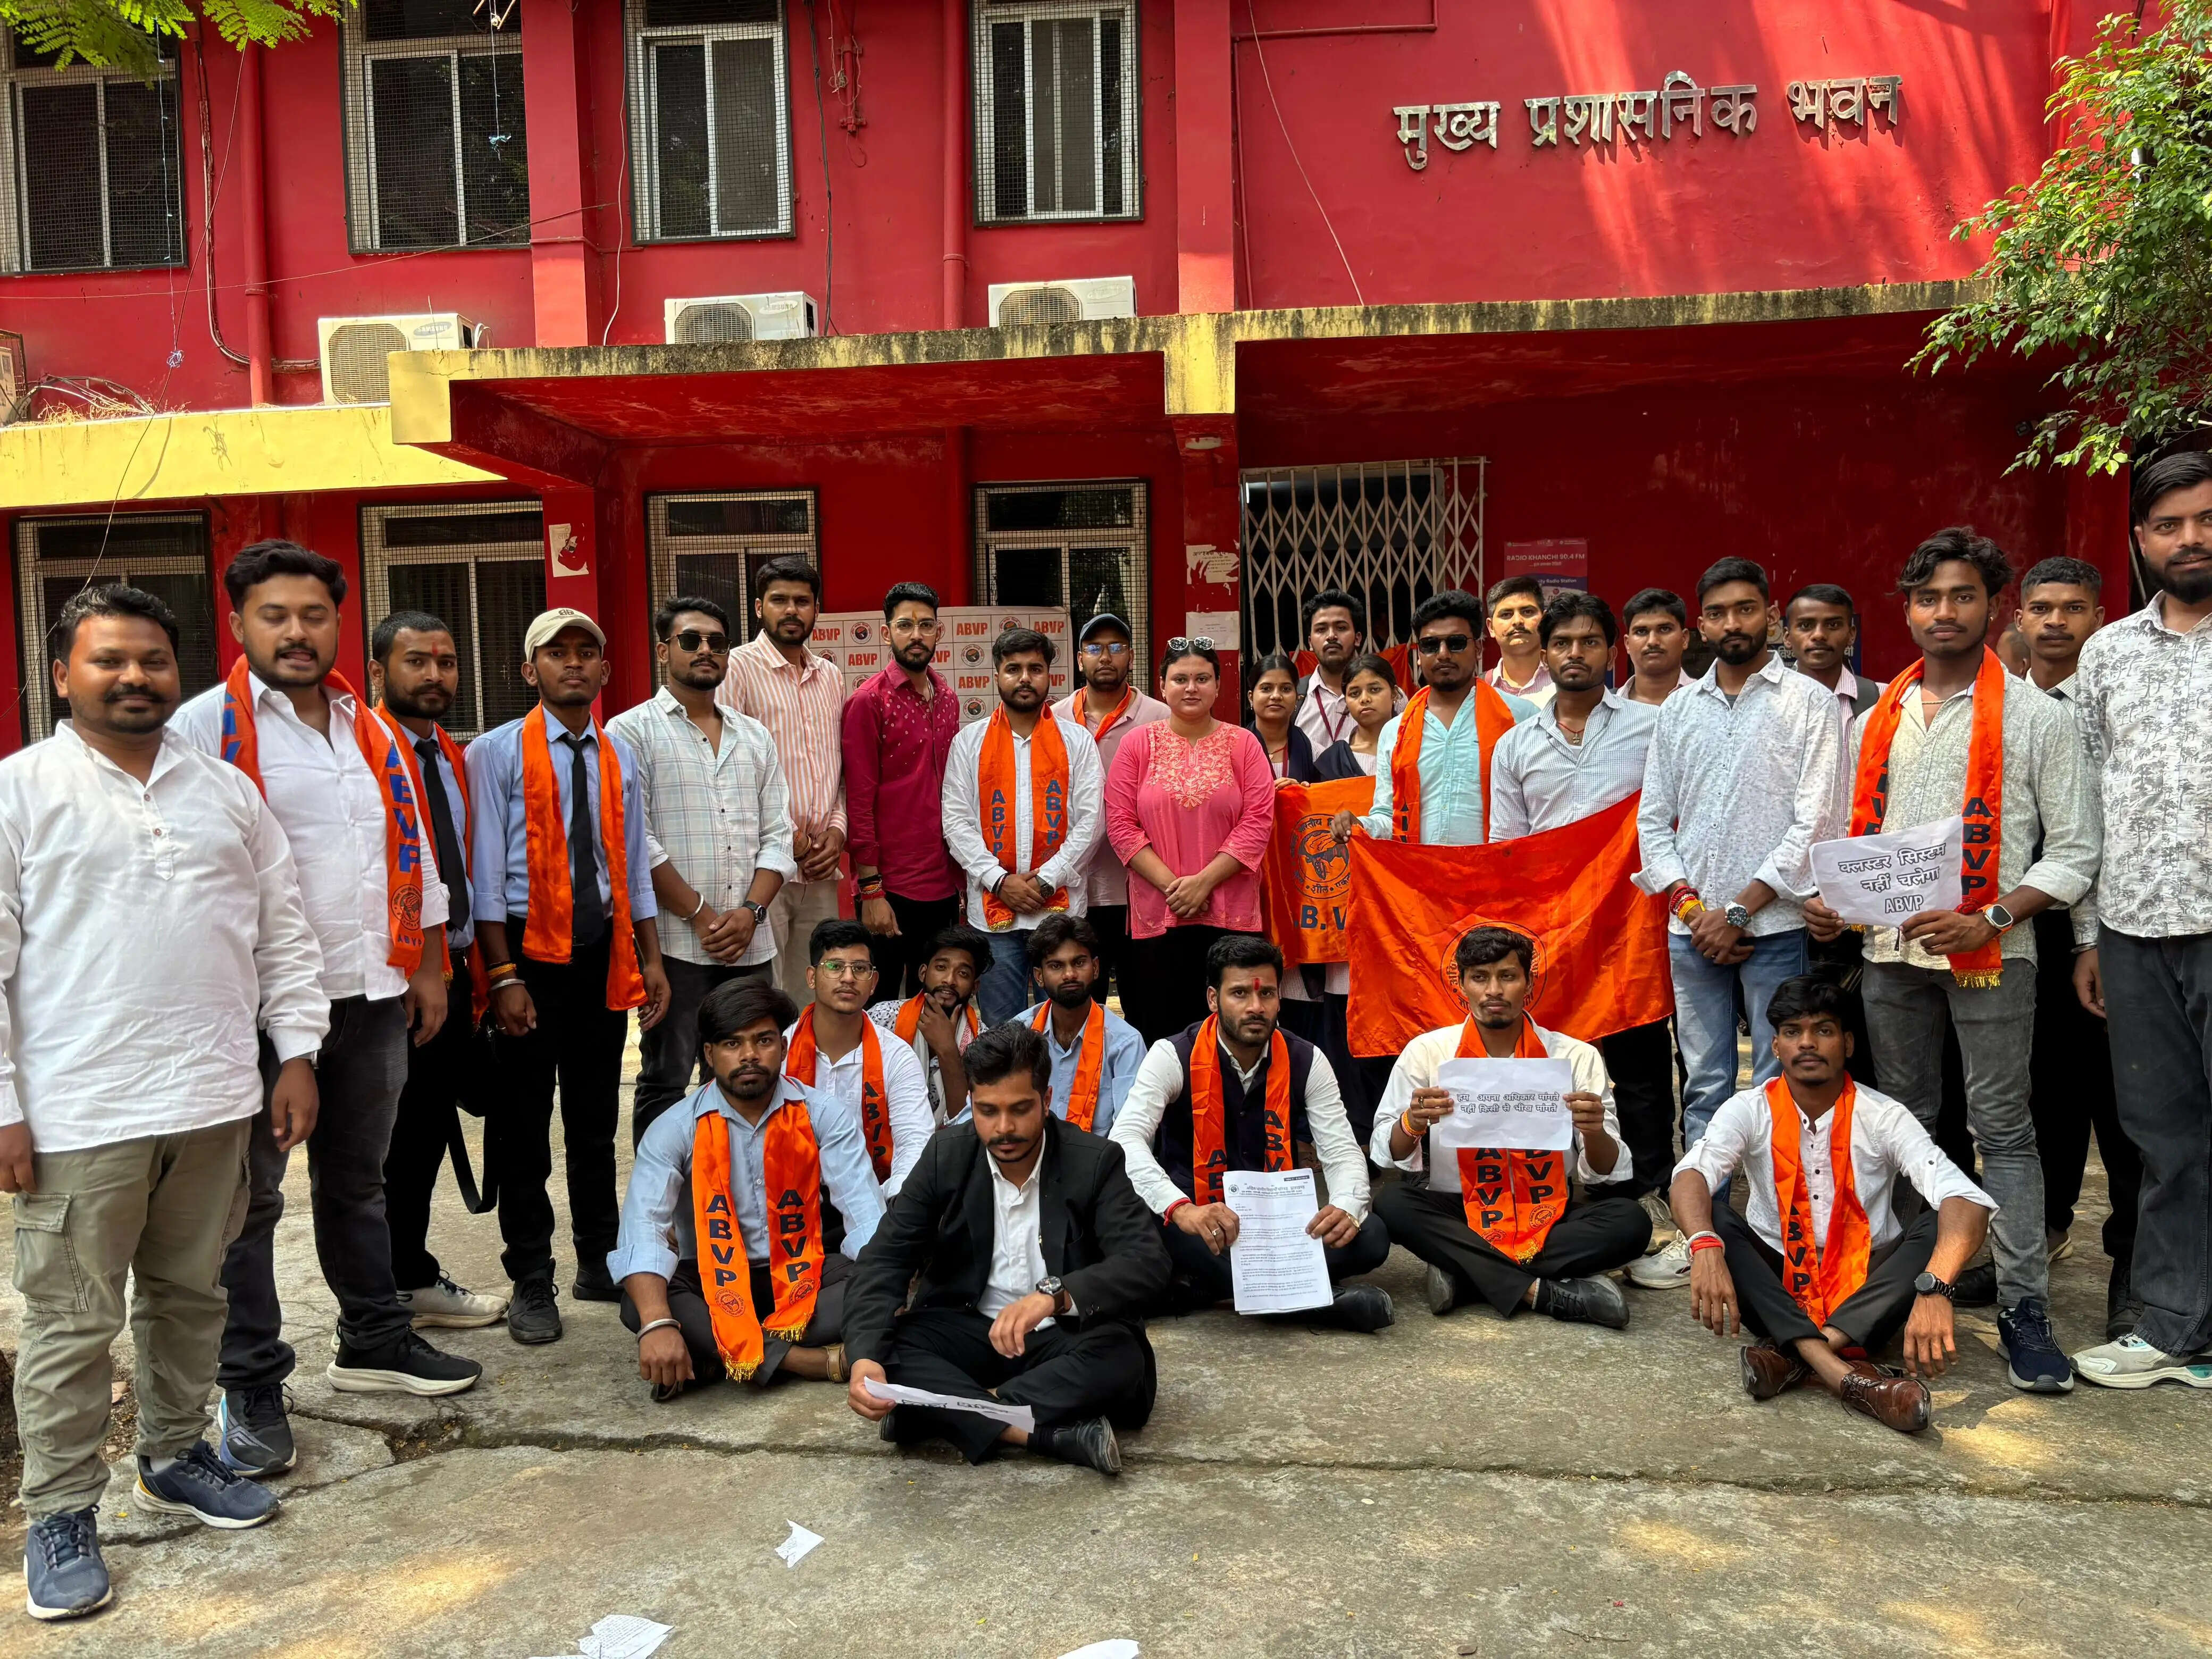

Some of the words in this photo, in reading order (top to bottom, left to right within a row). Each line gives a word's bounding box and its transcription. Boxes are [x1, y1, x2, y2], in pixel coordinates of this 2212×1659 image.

[1393, 101, 1500, 170] मुख्य
[1524, 71, 1757, 147] प्रशासनिक
[1787, 76, 1903, 129] भवन
[812, 629, 840, 641] ABVP
[957, 623, 988, 635] ABVP
[1034, 621, 1065, 634] ABVP
[848, 653, 877, 666] ABVP
[930, 650, 951, 663] VP
[958, 676, 990, 689] ABVP
[1049, 674, 1066, 687] VP
[1045, 780, 1062, 844] ABVP
[992, 789, 1006, 858] ABVP
[1961, 797, 1993, 895] ABVP
[1838, 855, 1891, 873] क्लस्टर
[1897, 843, 1946, 866] सिस्टम
[1861, 873, 1891, 893] नहीं
[1897, 866, 1940, 887] चलेगा
[1885, 894, 1924, 914] ABVP
[398, 934, 422, 946] ABVP
[1503, 1092, 1535, 1102] अधिकार
[1538, 1092, 1560, 1101] मांगते
[1461, 1103, 1476, 1113] नहीं
[1479, 1103, 1499, 1113] किसी
[1503, 1103, 1510, 1112] से
[1514, 1103, 1532, 1112] भीख
[1536, 1103, 1557, 1112] मांगते
[1264, 1110, 1285, 1172] ABV
[1474, 1148, 1504, 1229] ABVP
[706, 1195, 738, 1287] ABVP
[777, 1189, 811, 1283] ABVP
